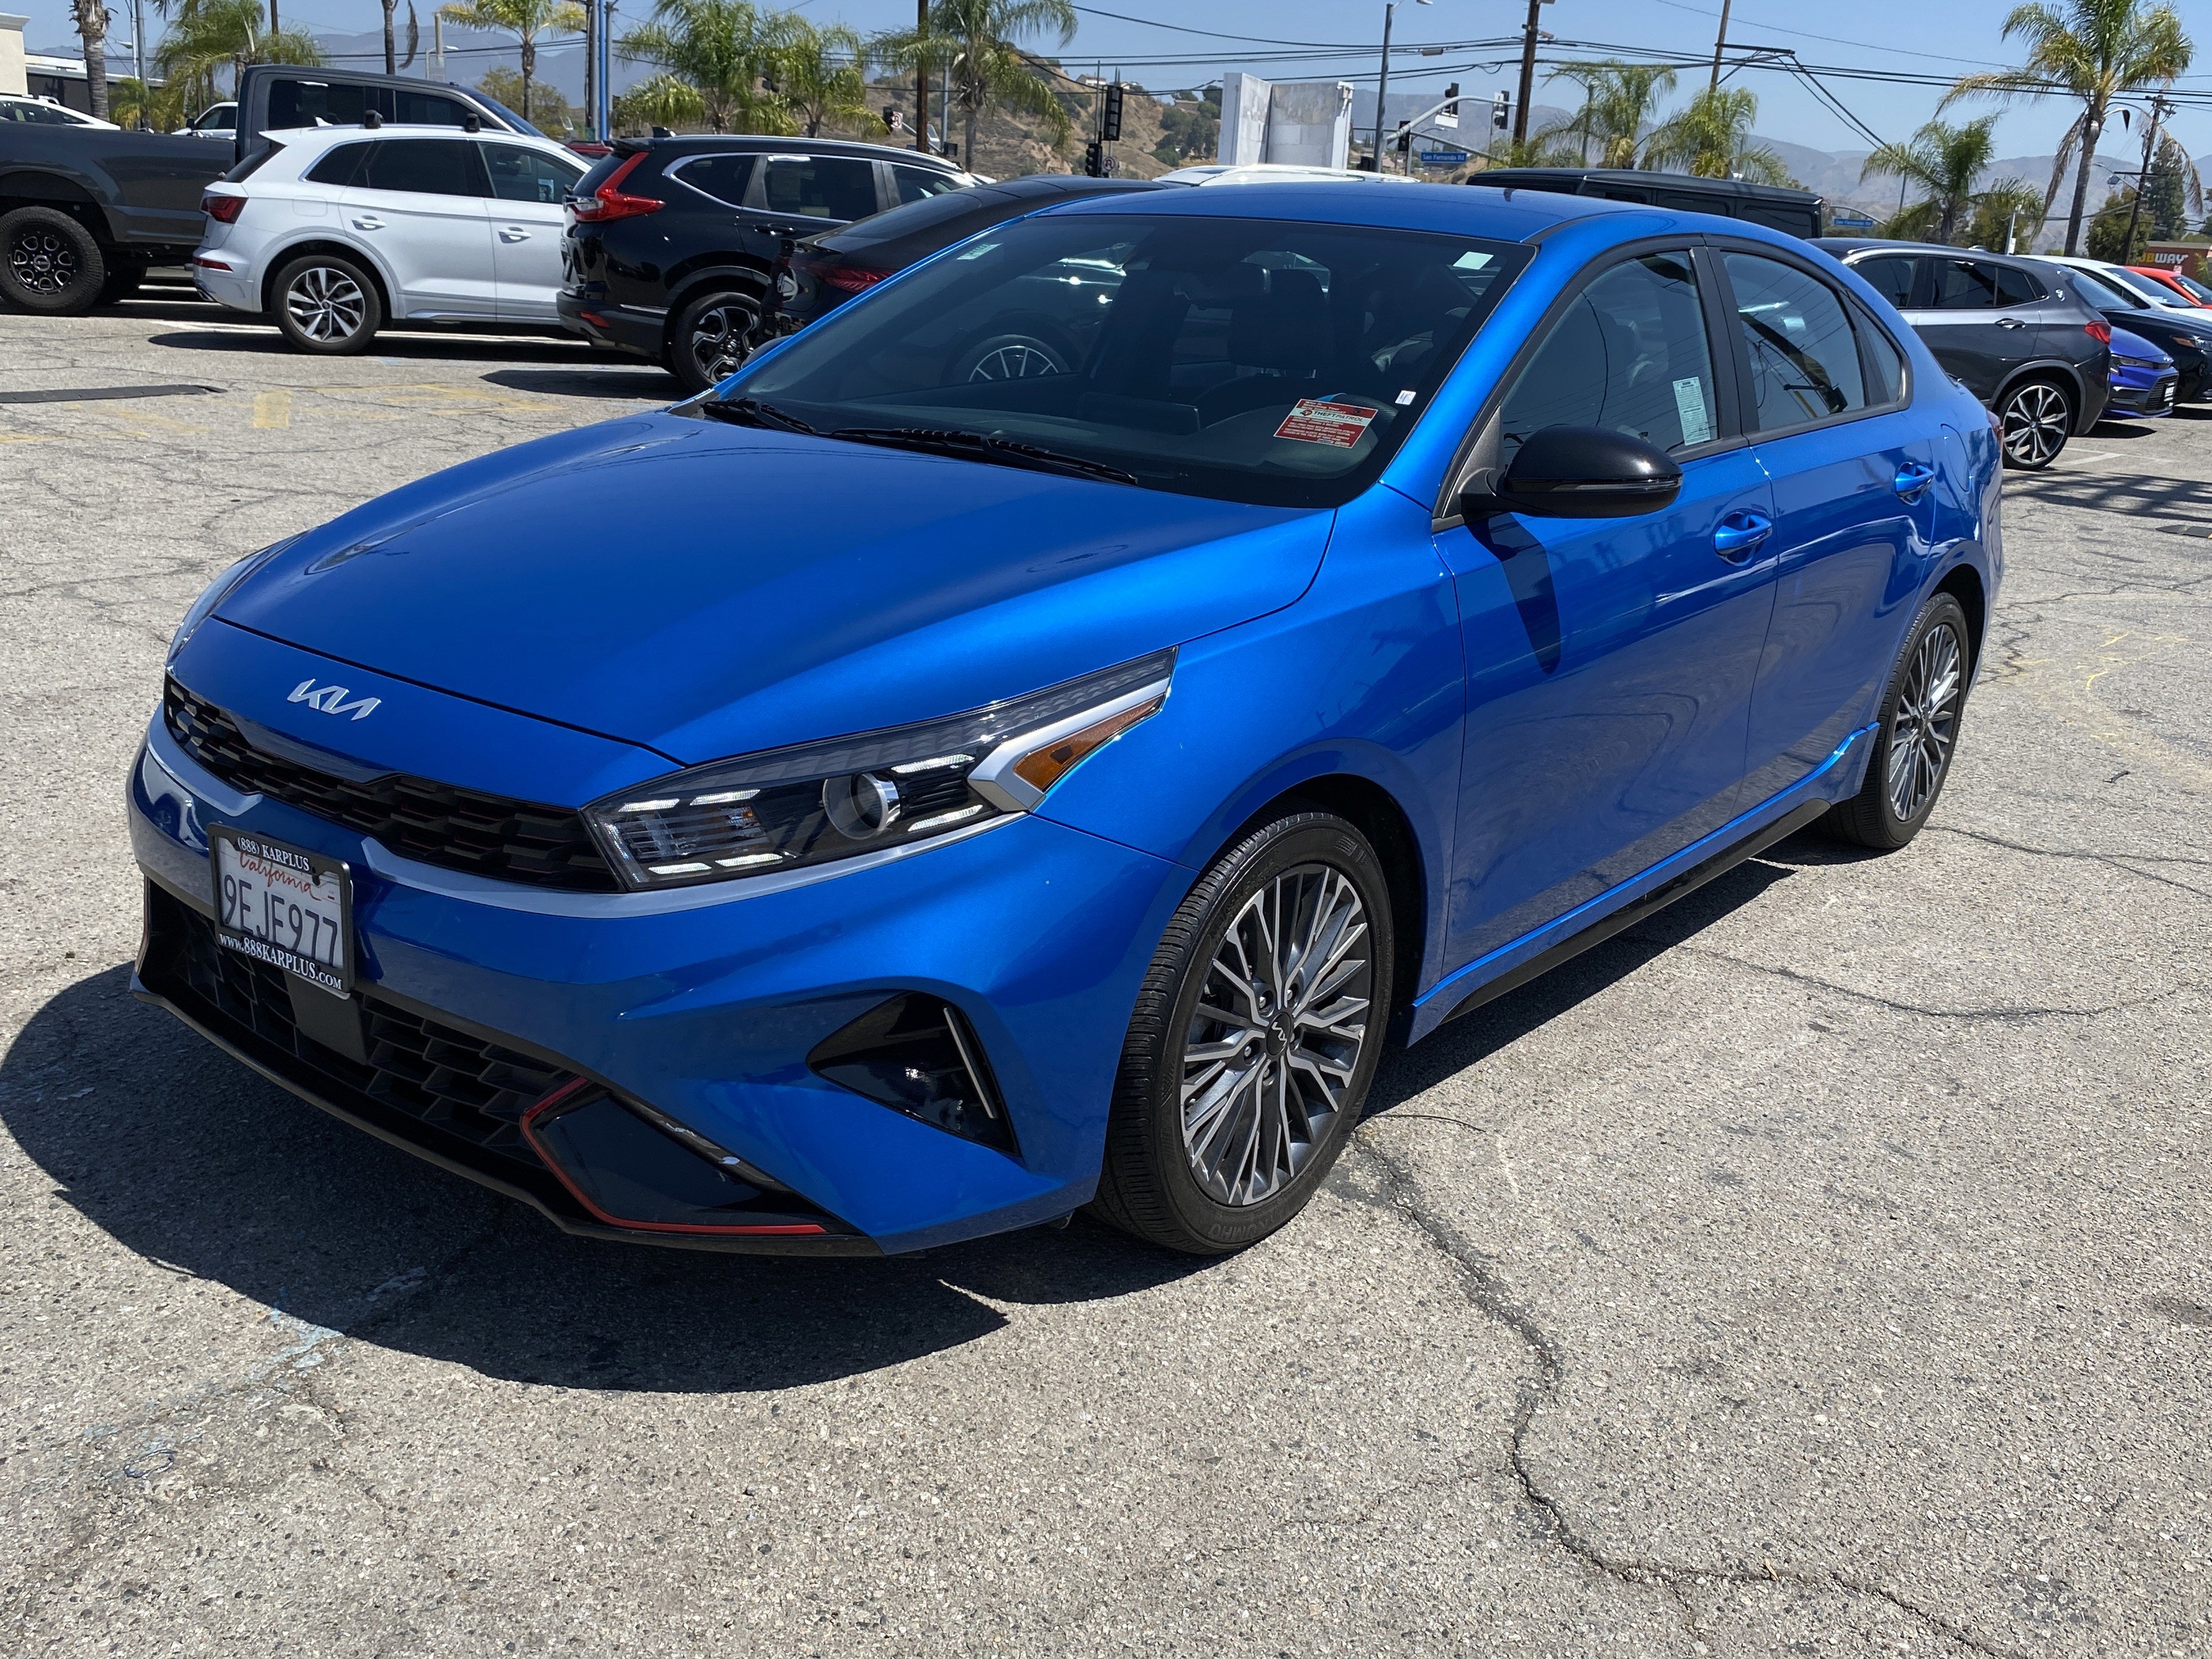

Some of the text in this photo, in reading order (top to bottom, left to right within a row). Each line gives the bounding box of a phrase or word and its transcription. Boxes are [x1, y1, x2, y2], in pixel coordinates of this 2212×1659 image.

[2139, 252, 2188, 264] UBWAY
[237, 837, 310, 871] (888) KARPLUS
[239, 851, 322, 901] California
[224, 874, 337, 966] 9EJE977
[1207, 1218, 1269, 1241] KUMHO
